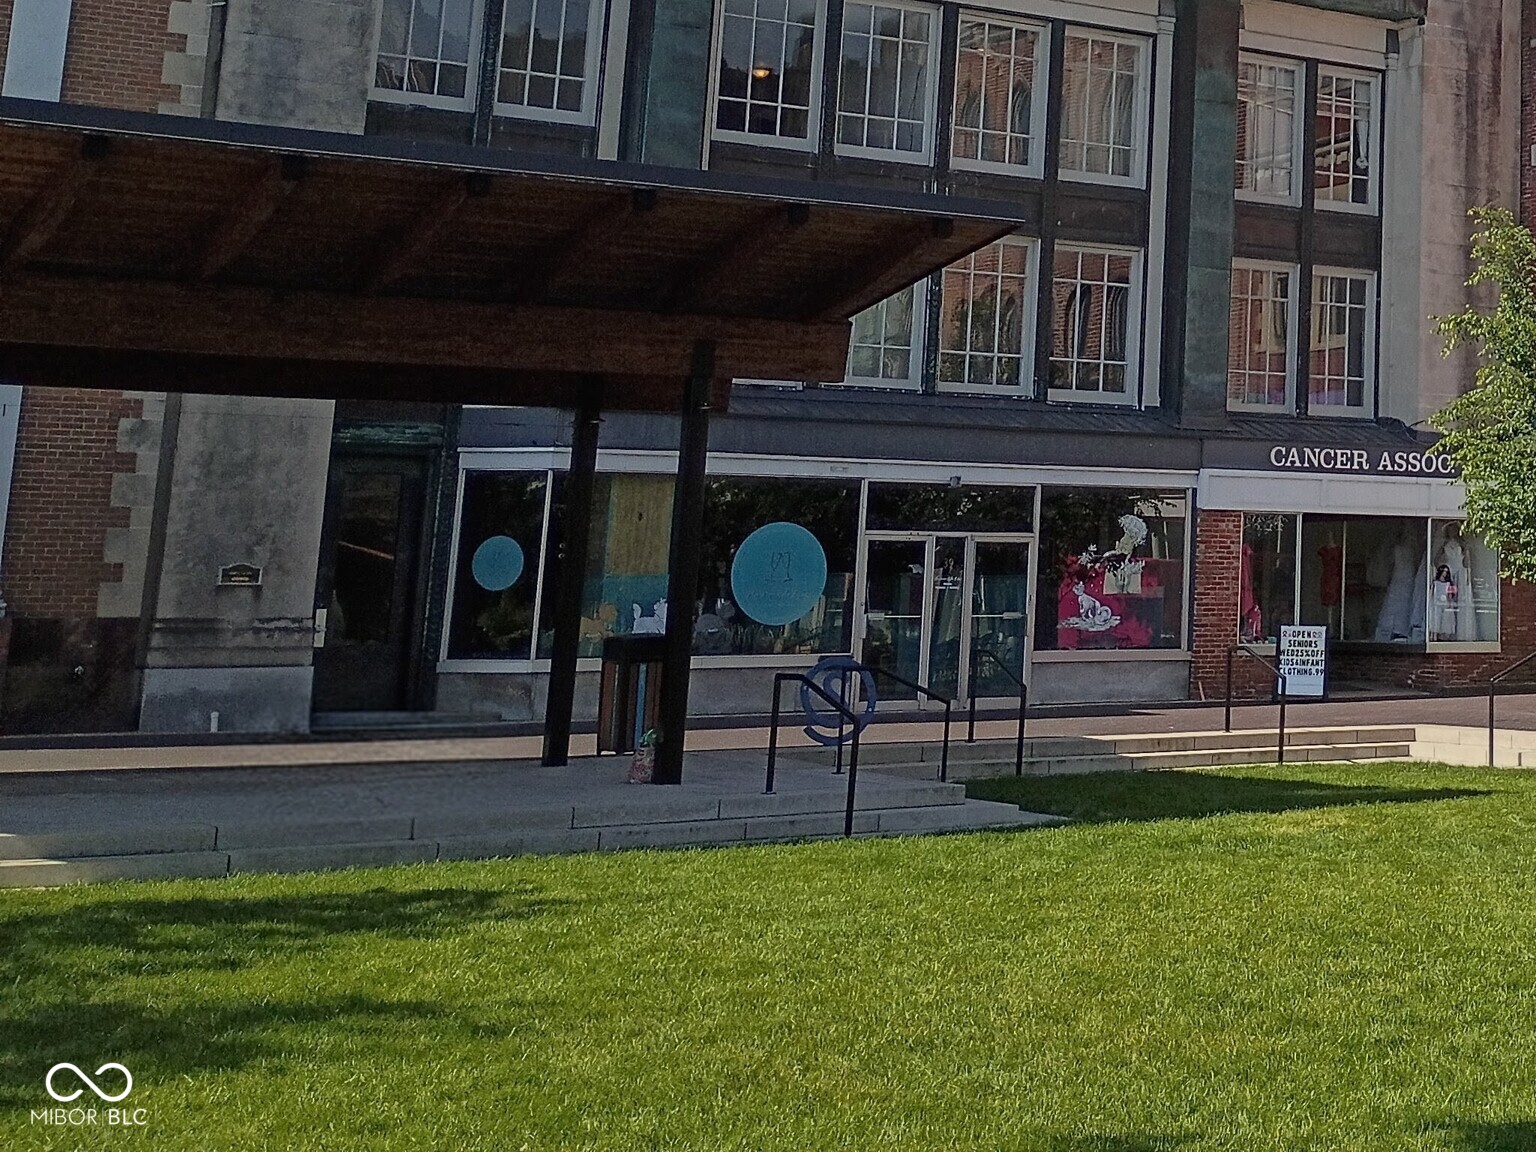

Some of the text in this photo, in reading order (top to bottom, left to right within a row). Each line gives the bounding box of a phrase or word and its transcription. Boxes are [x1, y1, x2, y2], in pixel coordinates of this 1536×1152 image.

[1270, 446, 1456, 474] CANCER ASSOC.
[1292, 630, 1312, 639] OPEN
[1288, 639, 1318, 648] SENIORS
